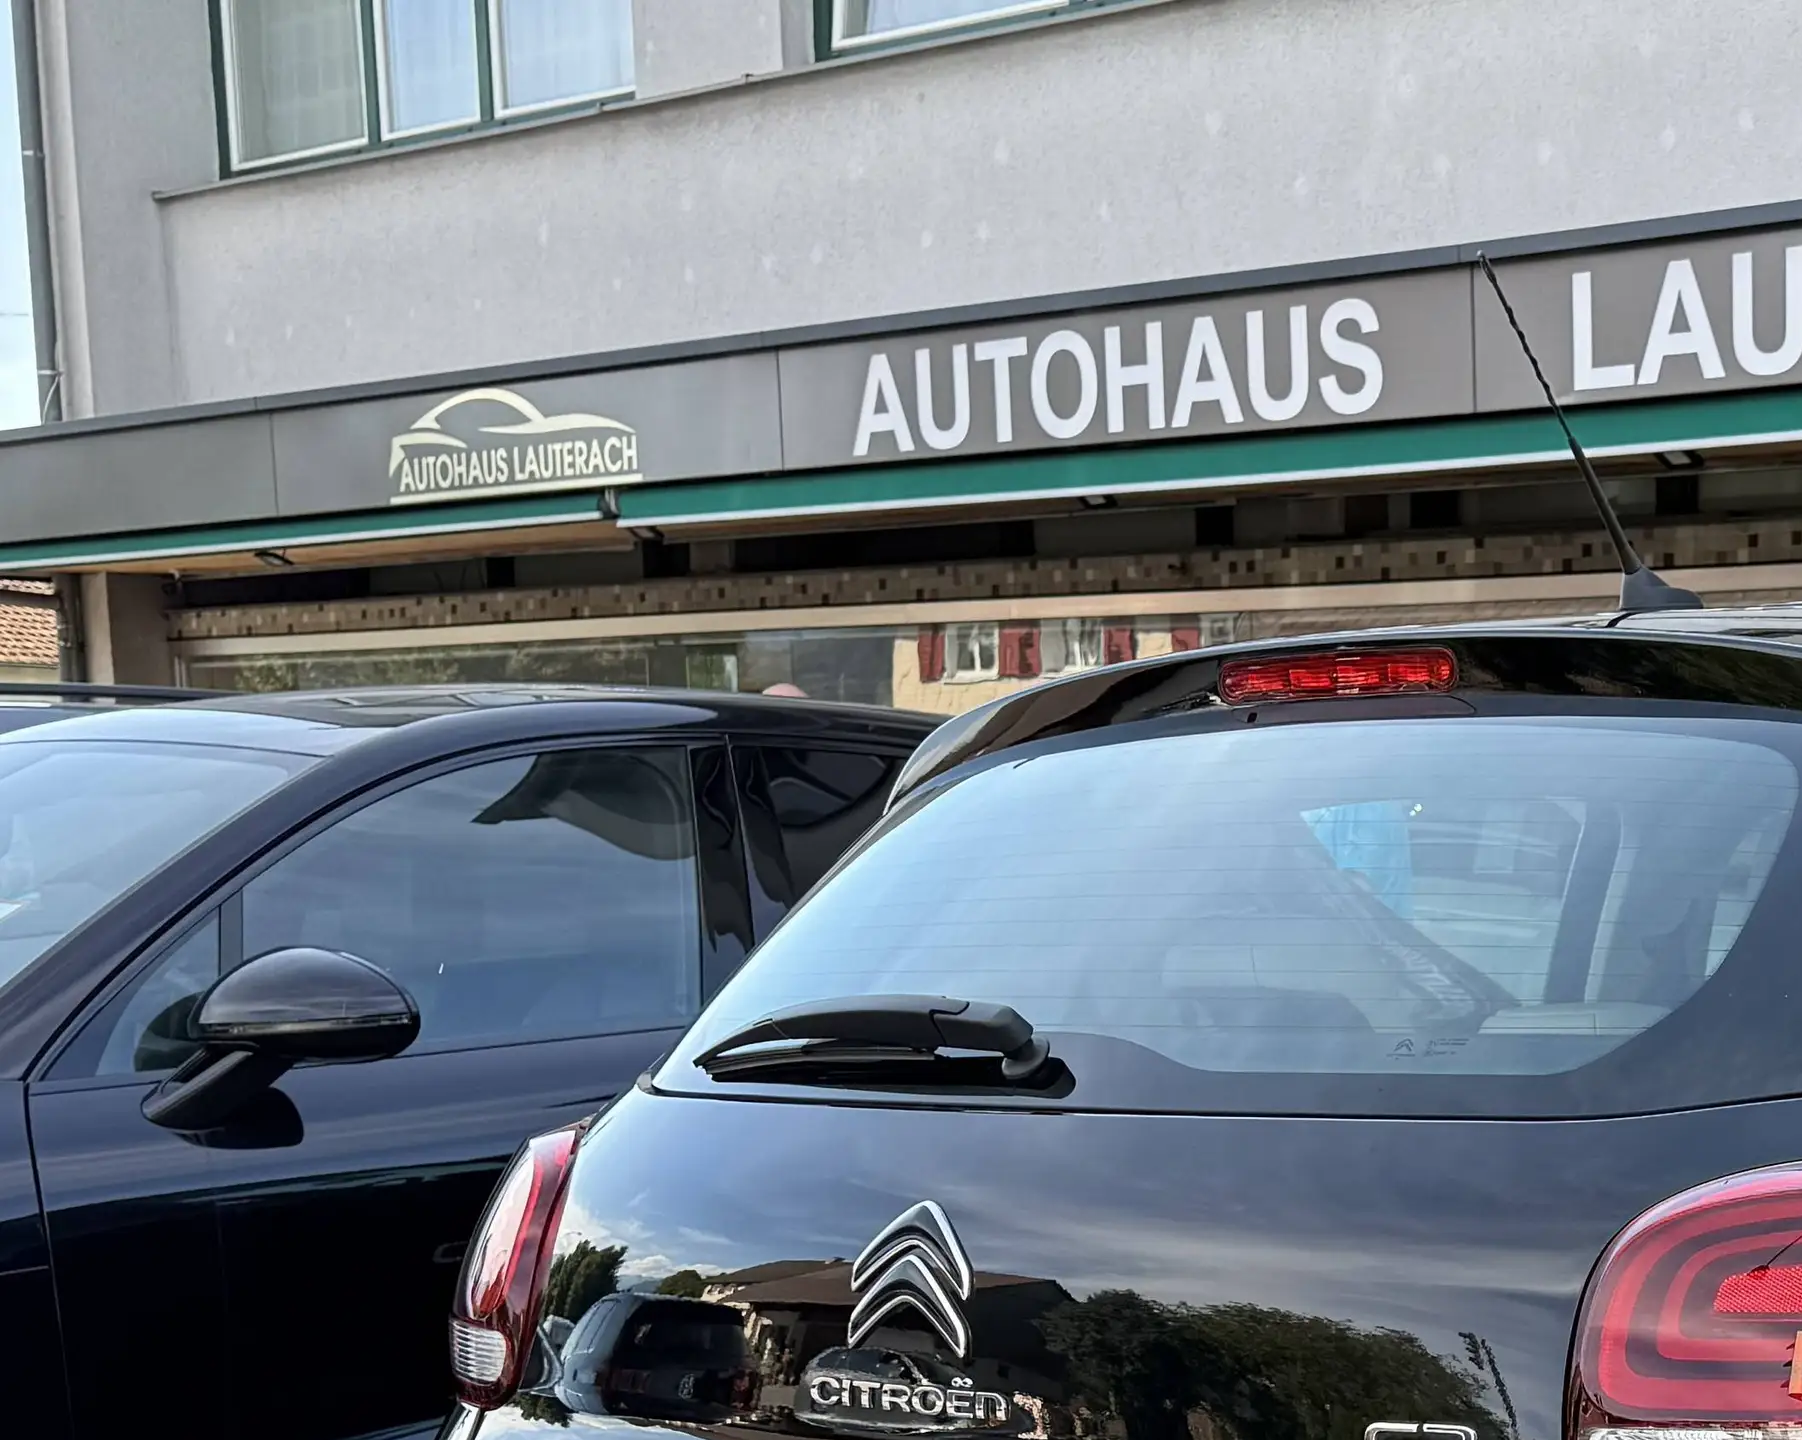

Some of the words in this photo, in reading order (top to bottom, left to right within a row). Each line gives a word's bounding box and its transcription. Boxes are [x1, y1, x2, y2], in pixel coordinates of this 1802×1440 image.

[852, 297, 1384, 457] AUTOHAUS
[399, 447, 509, 492] AUTOHAUS
[513, 434, 638, 481] LAUTERACH
[810, 1376, 1010, 1421] CITROËN
